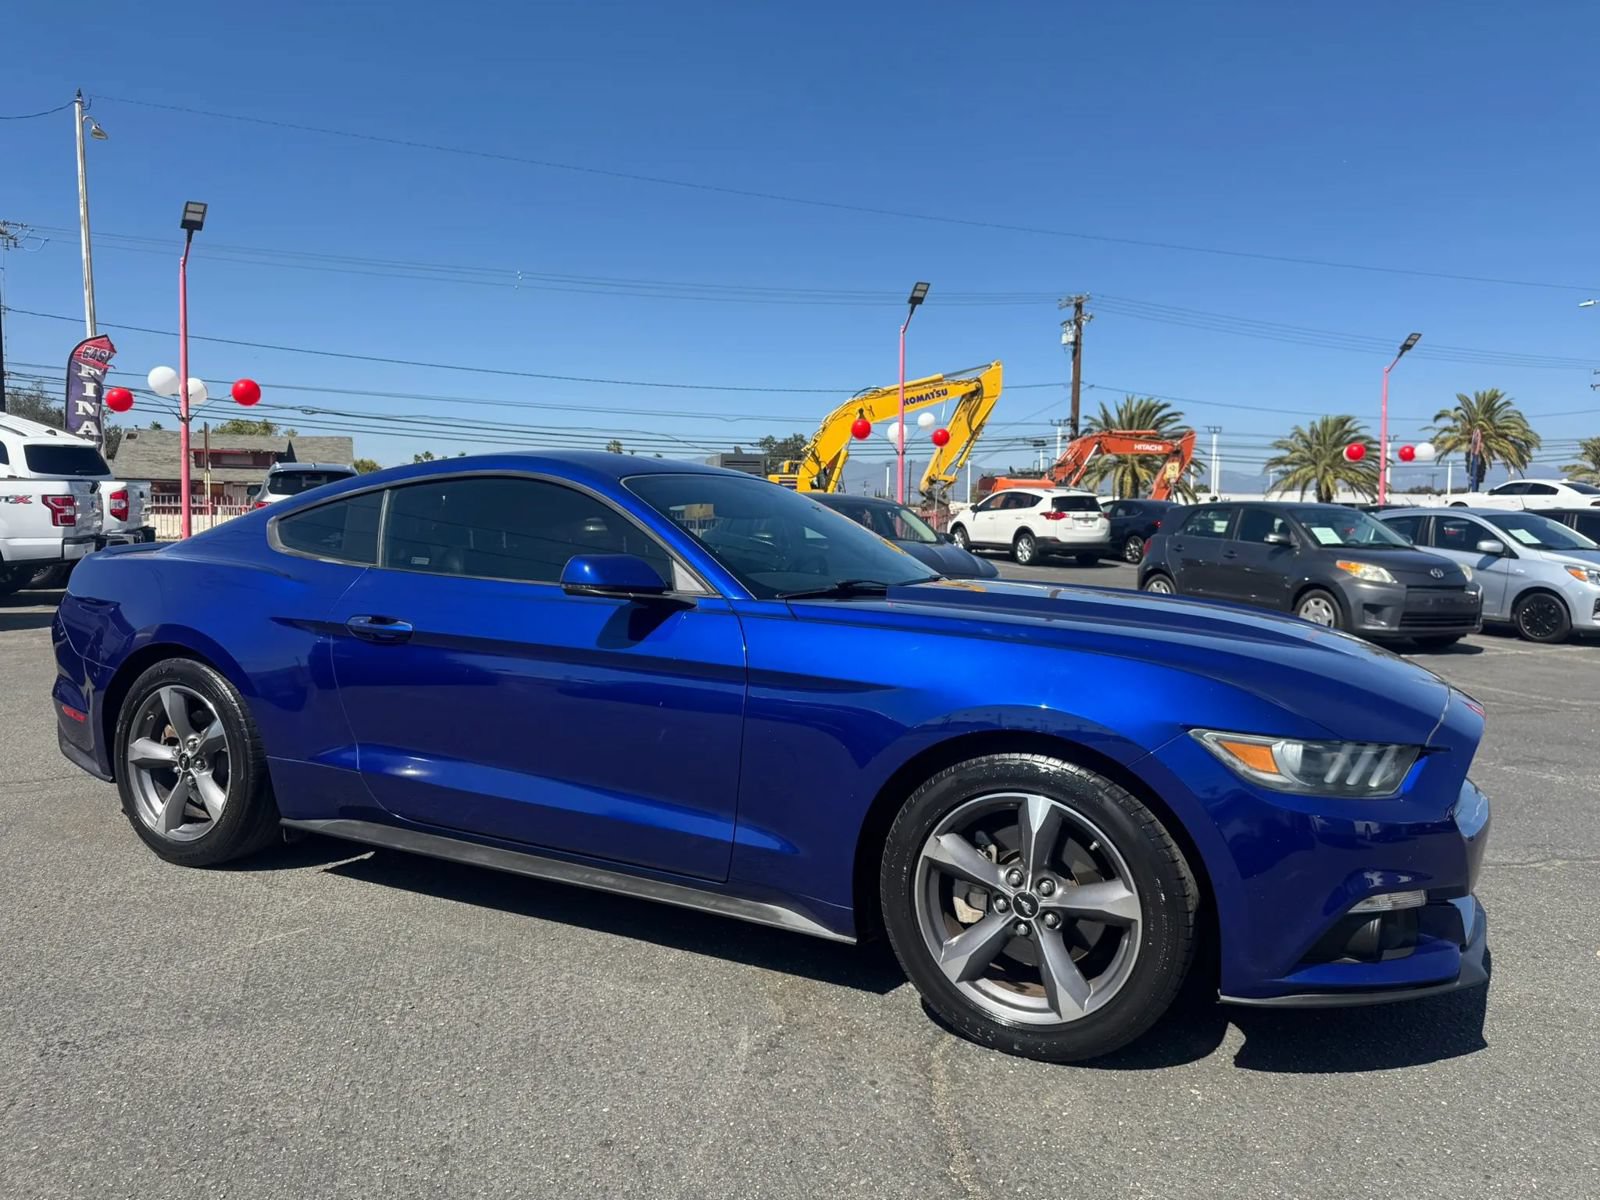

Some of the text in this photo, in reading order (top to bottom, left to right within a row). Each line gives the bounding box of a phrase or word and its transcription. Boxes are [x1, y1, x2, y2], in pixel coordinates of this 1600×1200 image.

[903, 388, 948, 406] KOMATSU
[75, 363, 102, 450] FINA
[1133, 443, 1163, 451] HITACHI
